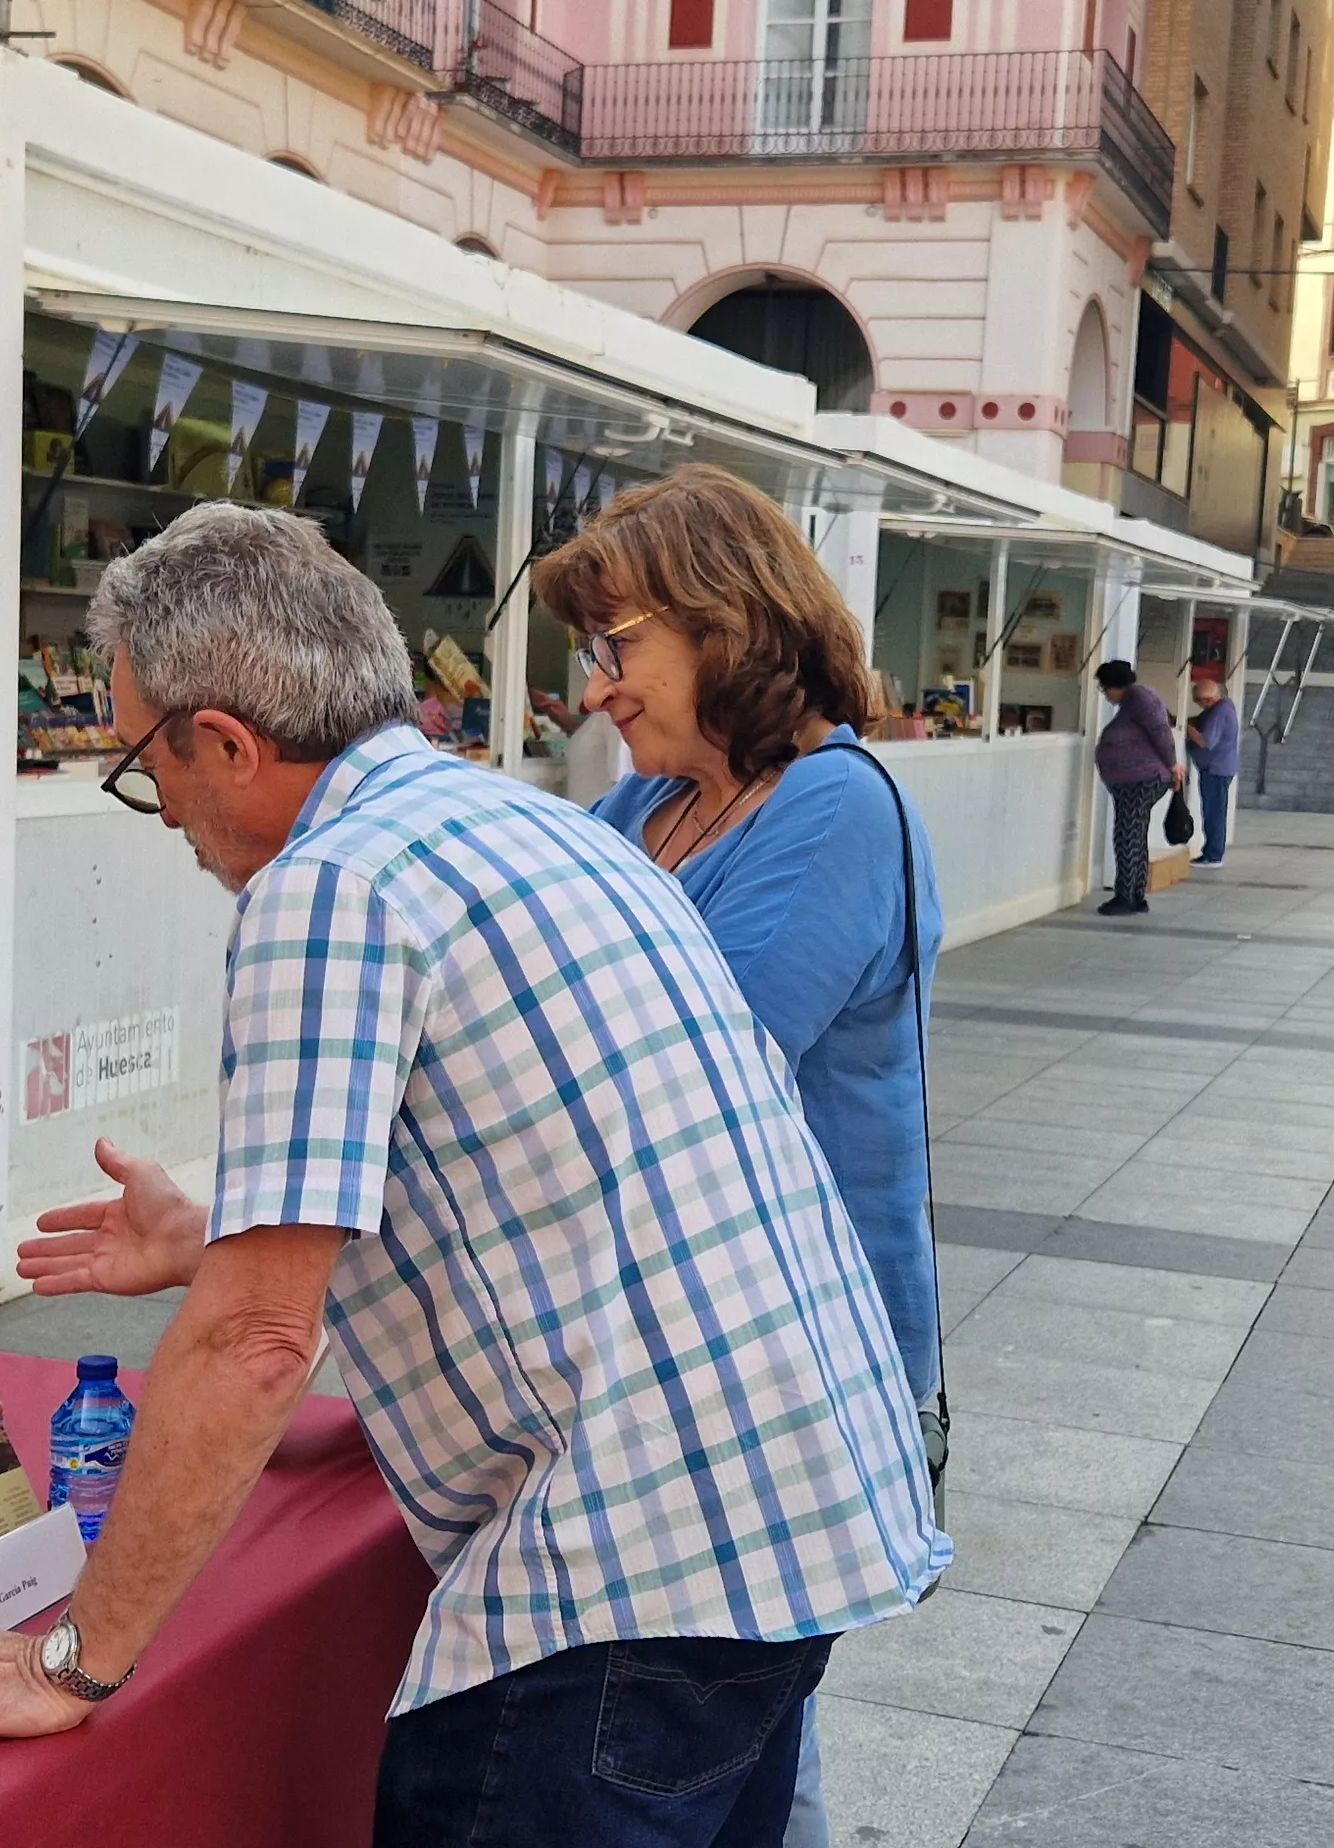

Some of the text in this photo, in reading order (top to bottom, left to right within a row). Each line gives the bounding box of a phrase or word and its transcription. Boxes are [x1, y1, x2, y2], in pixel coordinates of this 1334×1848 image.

[77, 1014, 175, 1058] Ayuntamento
[98, 1052, 152, 1081] Huesca
[22, 1575, 38, 1591] Puig
